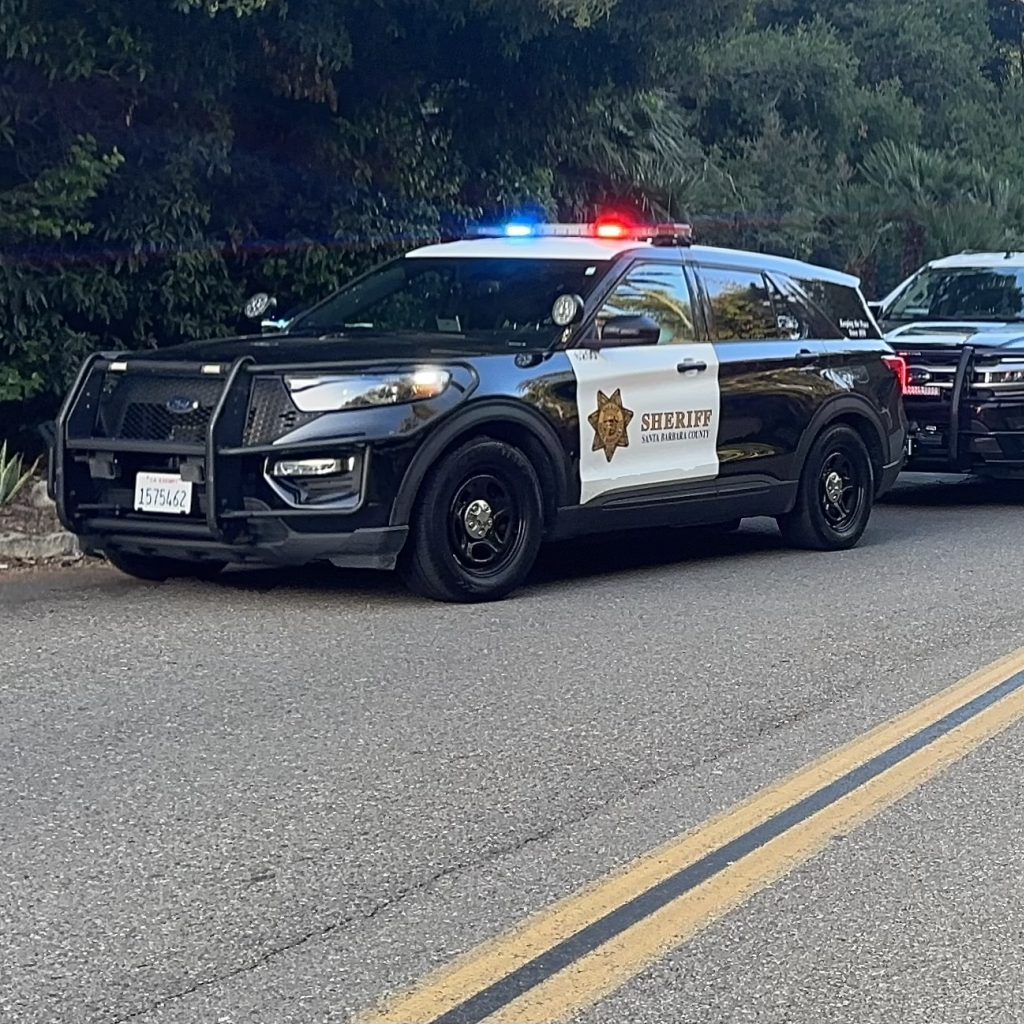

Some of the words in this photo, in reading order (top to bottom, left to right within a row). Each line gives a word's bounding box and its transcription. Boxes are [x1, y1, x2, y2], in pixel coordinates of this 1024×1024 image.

[641, 410, 712, 431] SHERIFF
[641, 432, 660, 444] SANTA
[660, 431, 687, 442] BARBARA
[688, 429, 709, 440] COUNTY
[139, 488, 187, 507] 1575462
